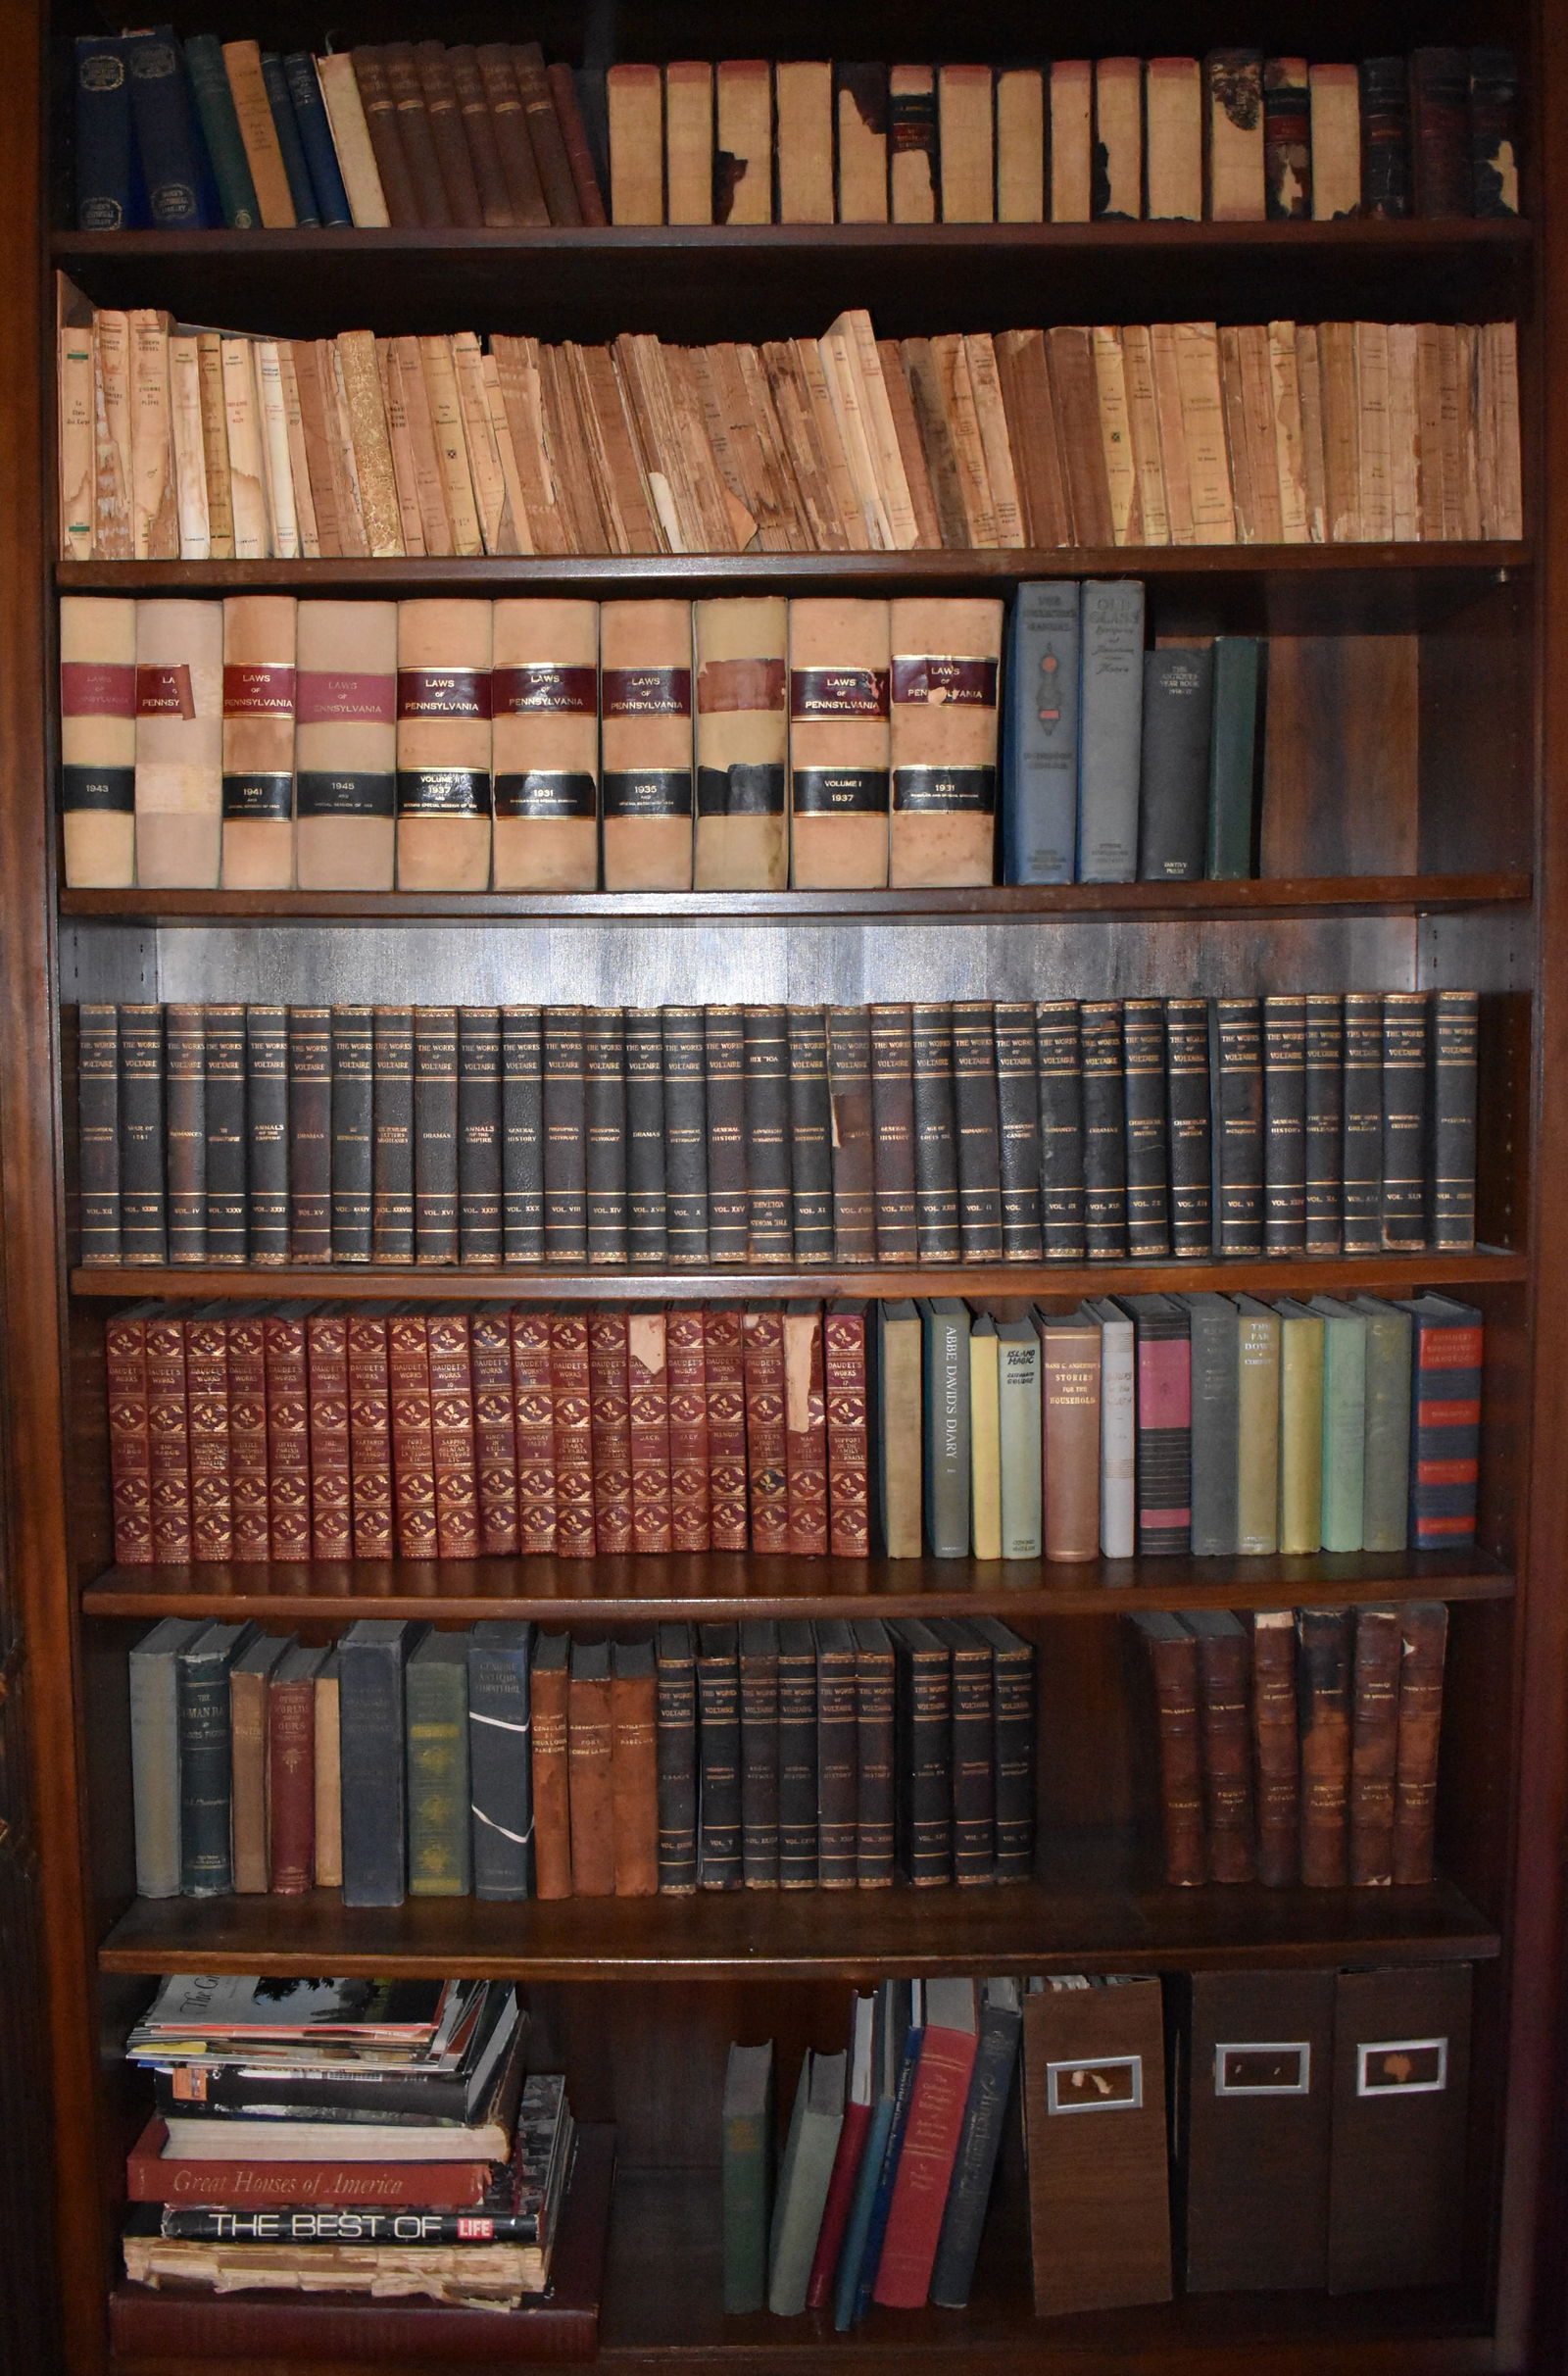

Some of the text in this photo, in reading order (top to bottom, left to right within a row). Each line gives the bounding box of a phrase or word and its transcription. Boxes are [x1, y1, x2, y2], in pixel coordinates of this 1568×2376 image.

[224, 699, 293, 708] PENNSYLVANIA
[405, 702, 478, 711] PENNSYLVANIA
[946, 1326, 956, 1361] ABBE
[1007, 1357, 1034, 1365] MAGIC
[946, 1365, 957, 1414] DAVID'S
[946, 1419, 957, 1459] DIARY
[173, 2170, 404, 2196] Great Houses of America
[208, 2213, 492, 2239] THE BEST OF LIFE
